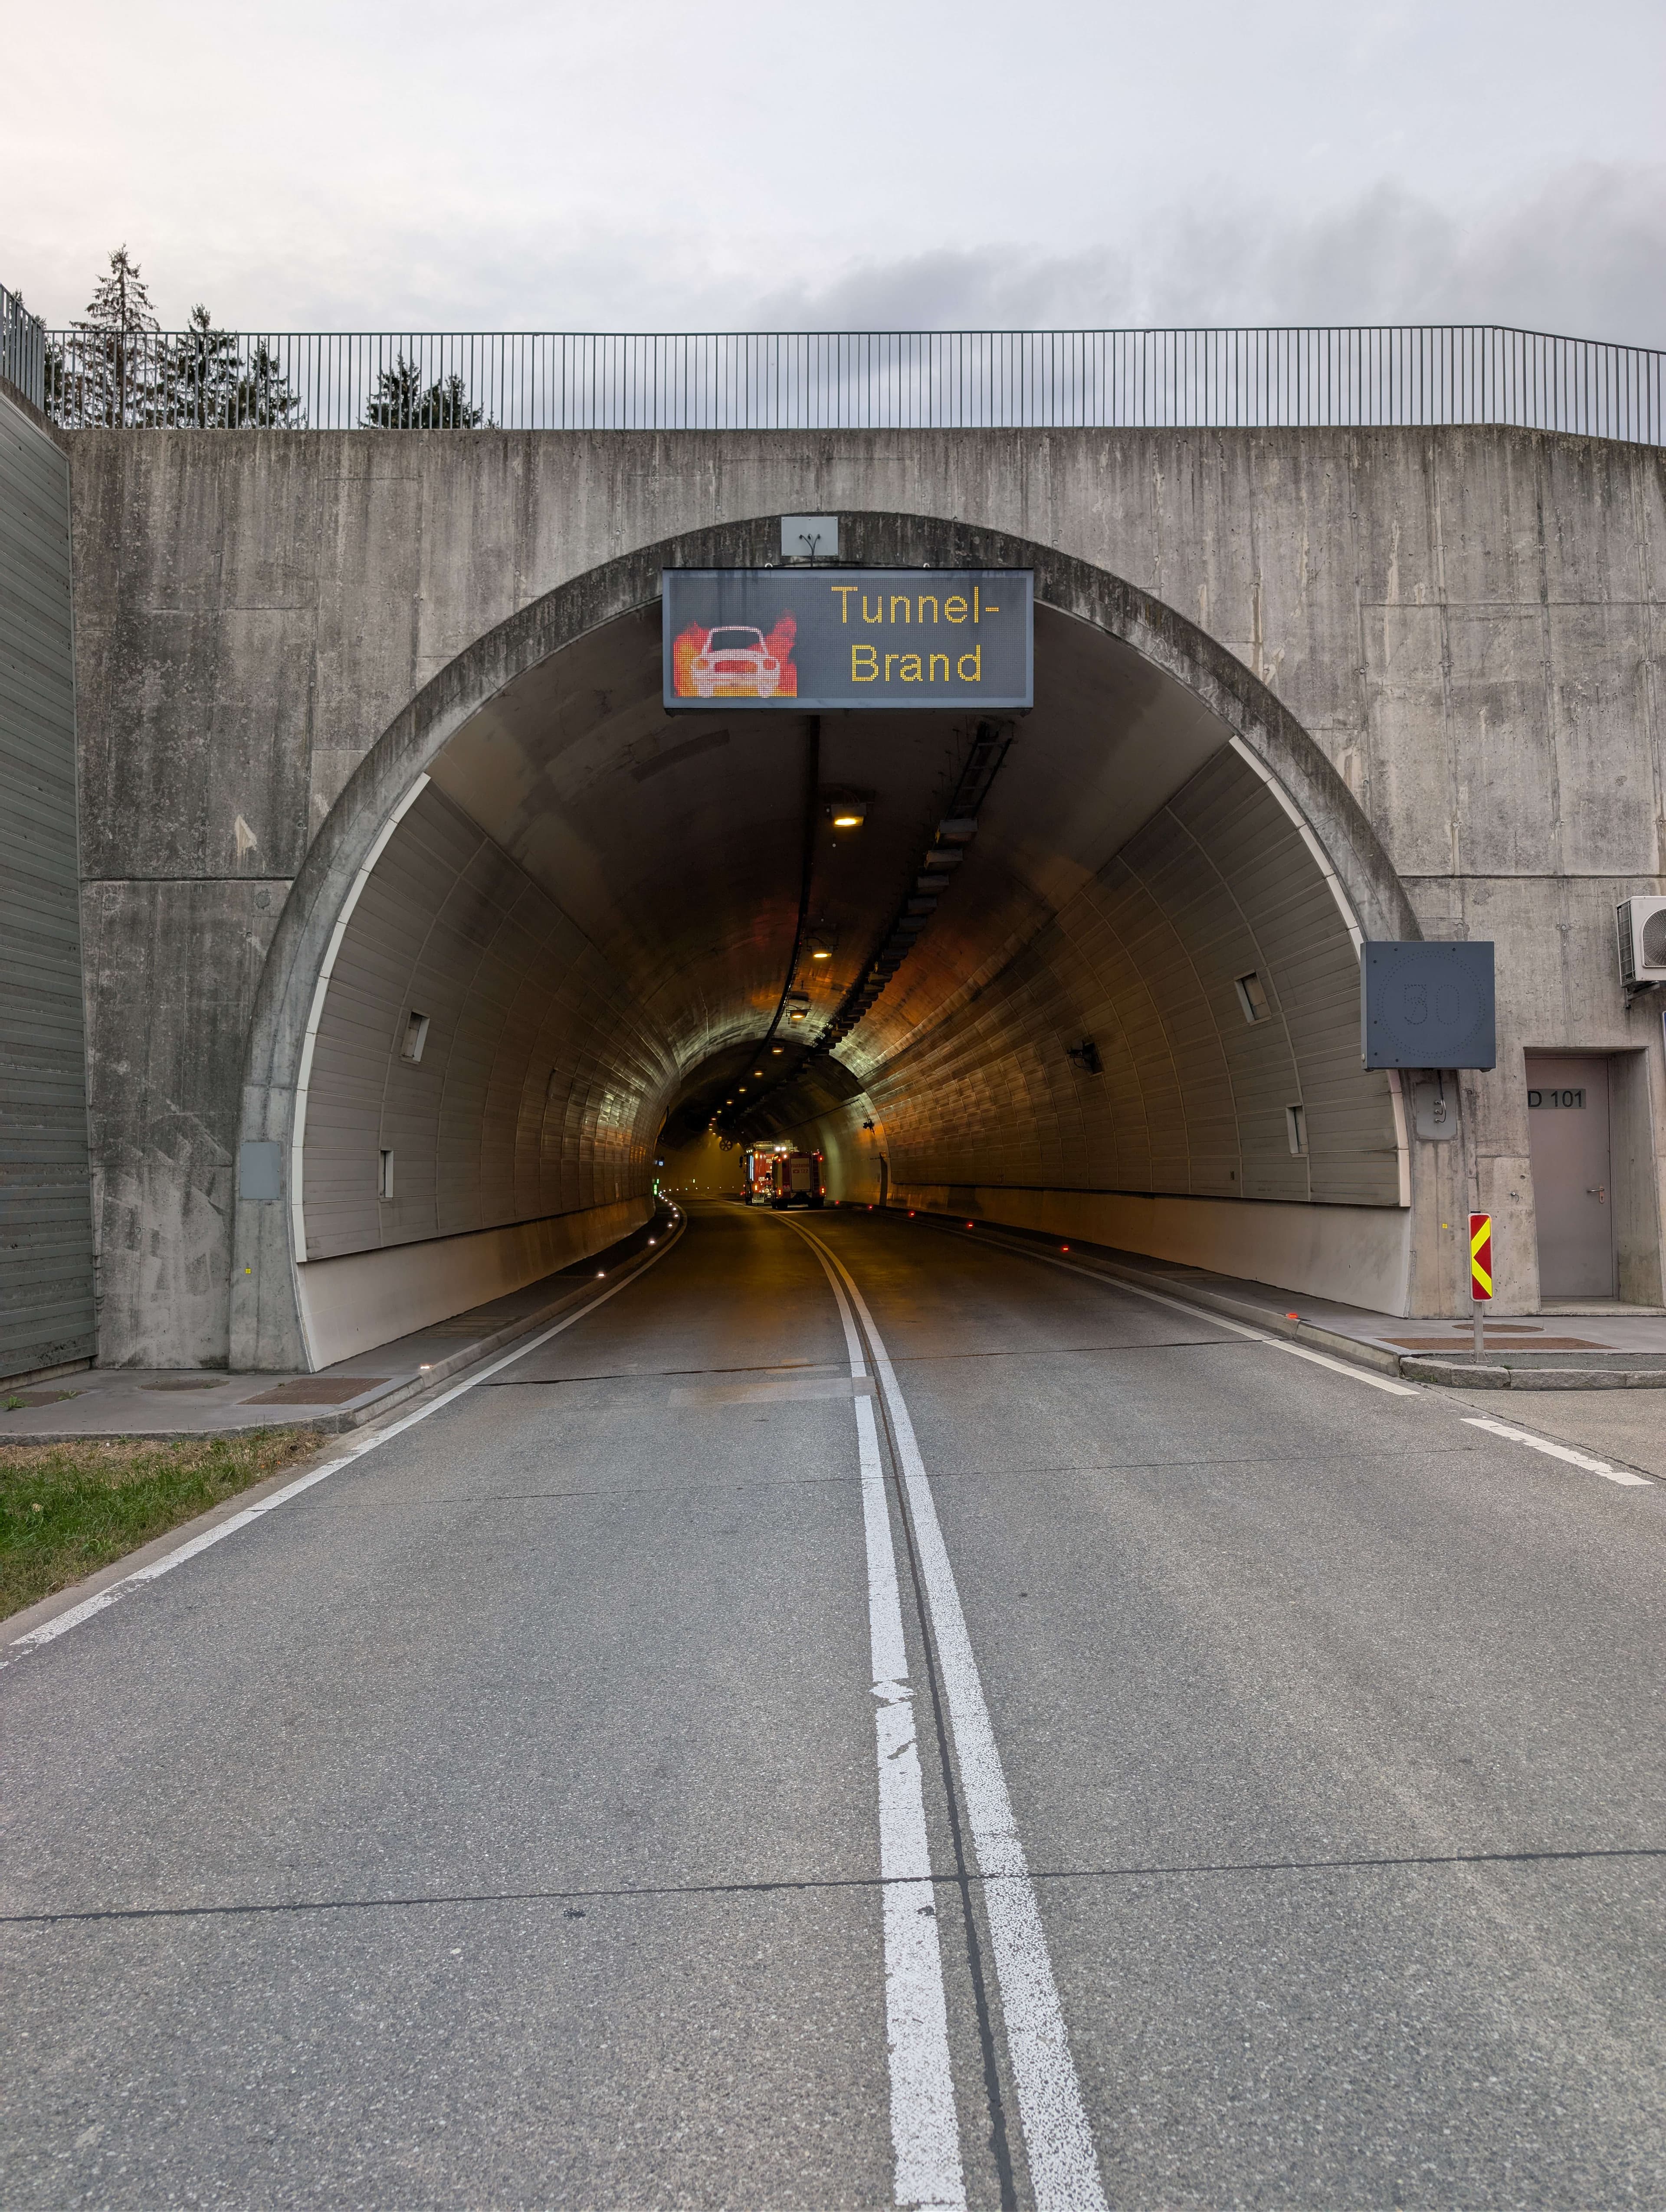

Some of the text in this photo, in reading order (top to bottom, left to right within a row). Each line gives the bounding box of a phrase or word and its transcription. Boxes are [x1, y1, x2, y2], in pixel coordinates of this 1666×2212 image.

[831, 586, 999, 623] Tunnel-
[852, 645, 981, 681] Brand
[1528, 1090, 1582, 1107] D 101
